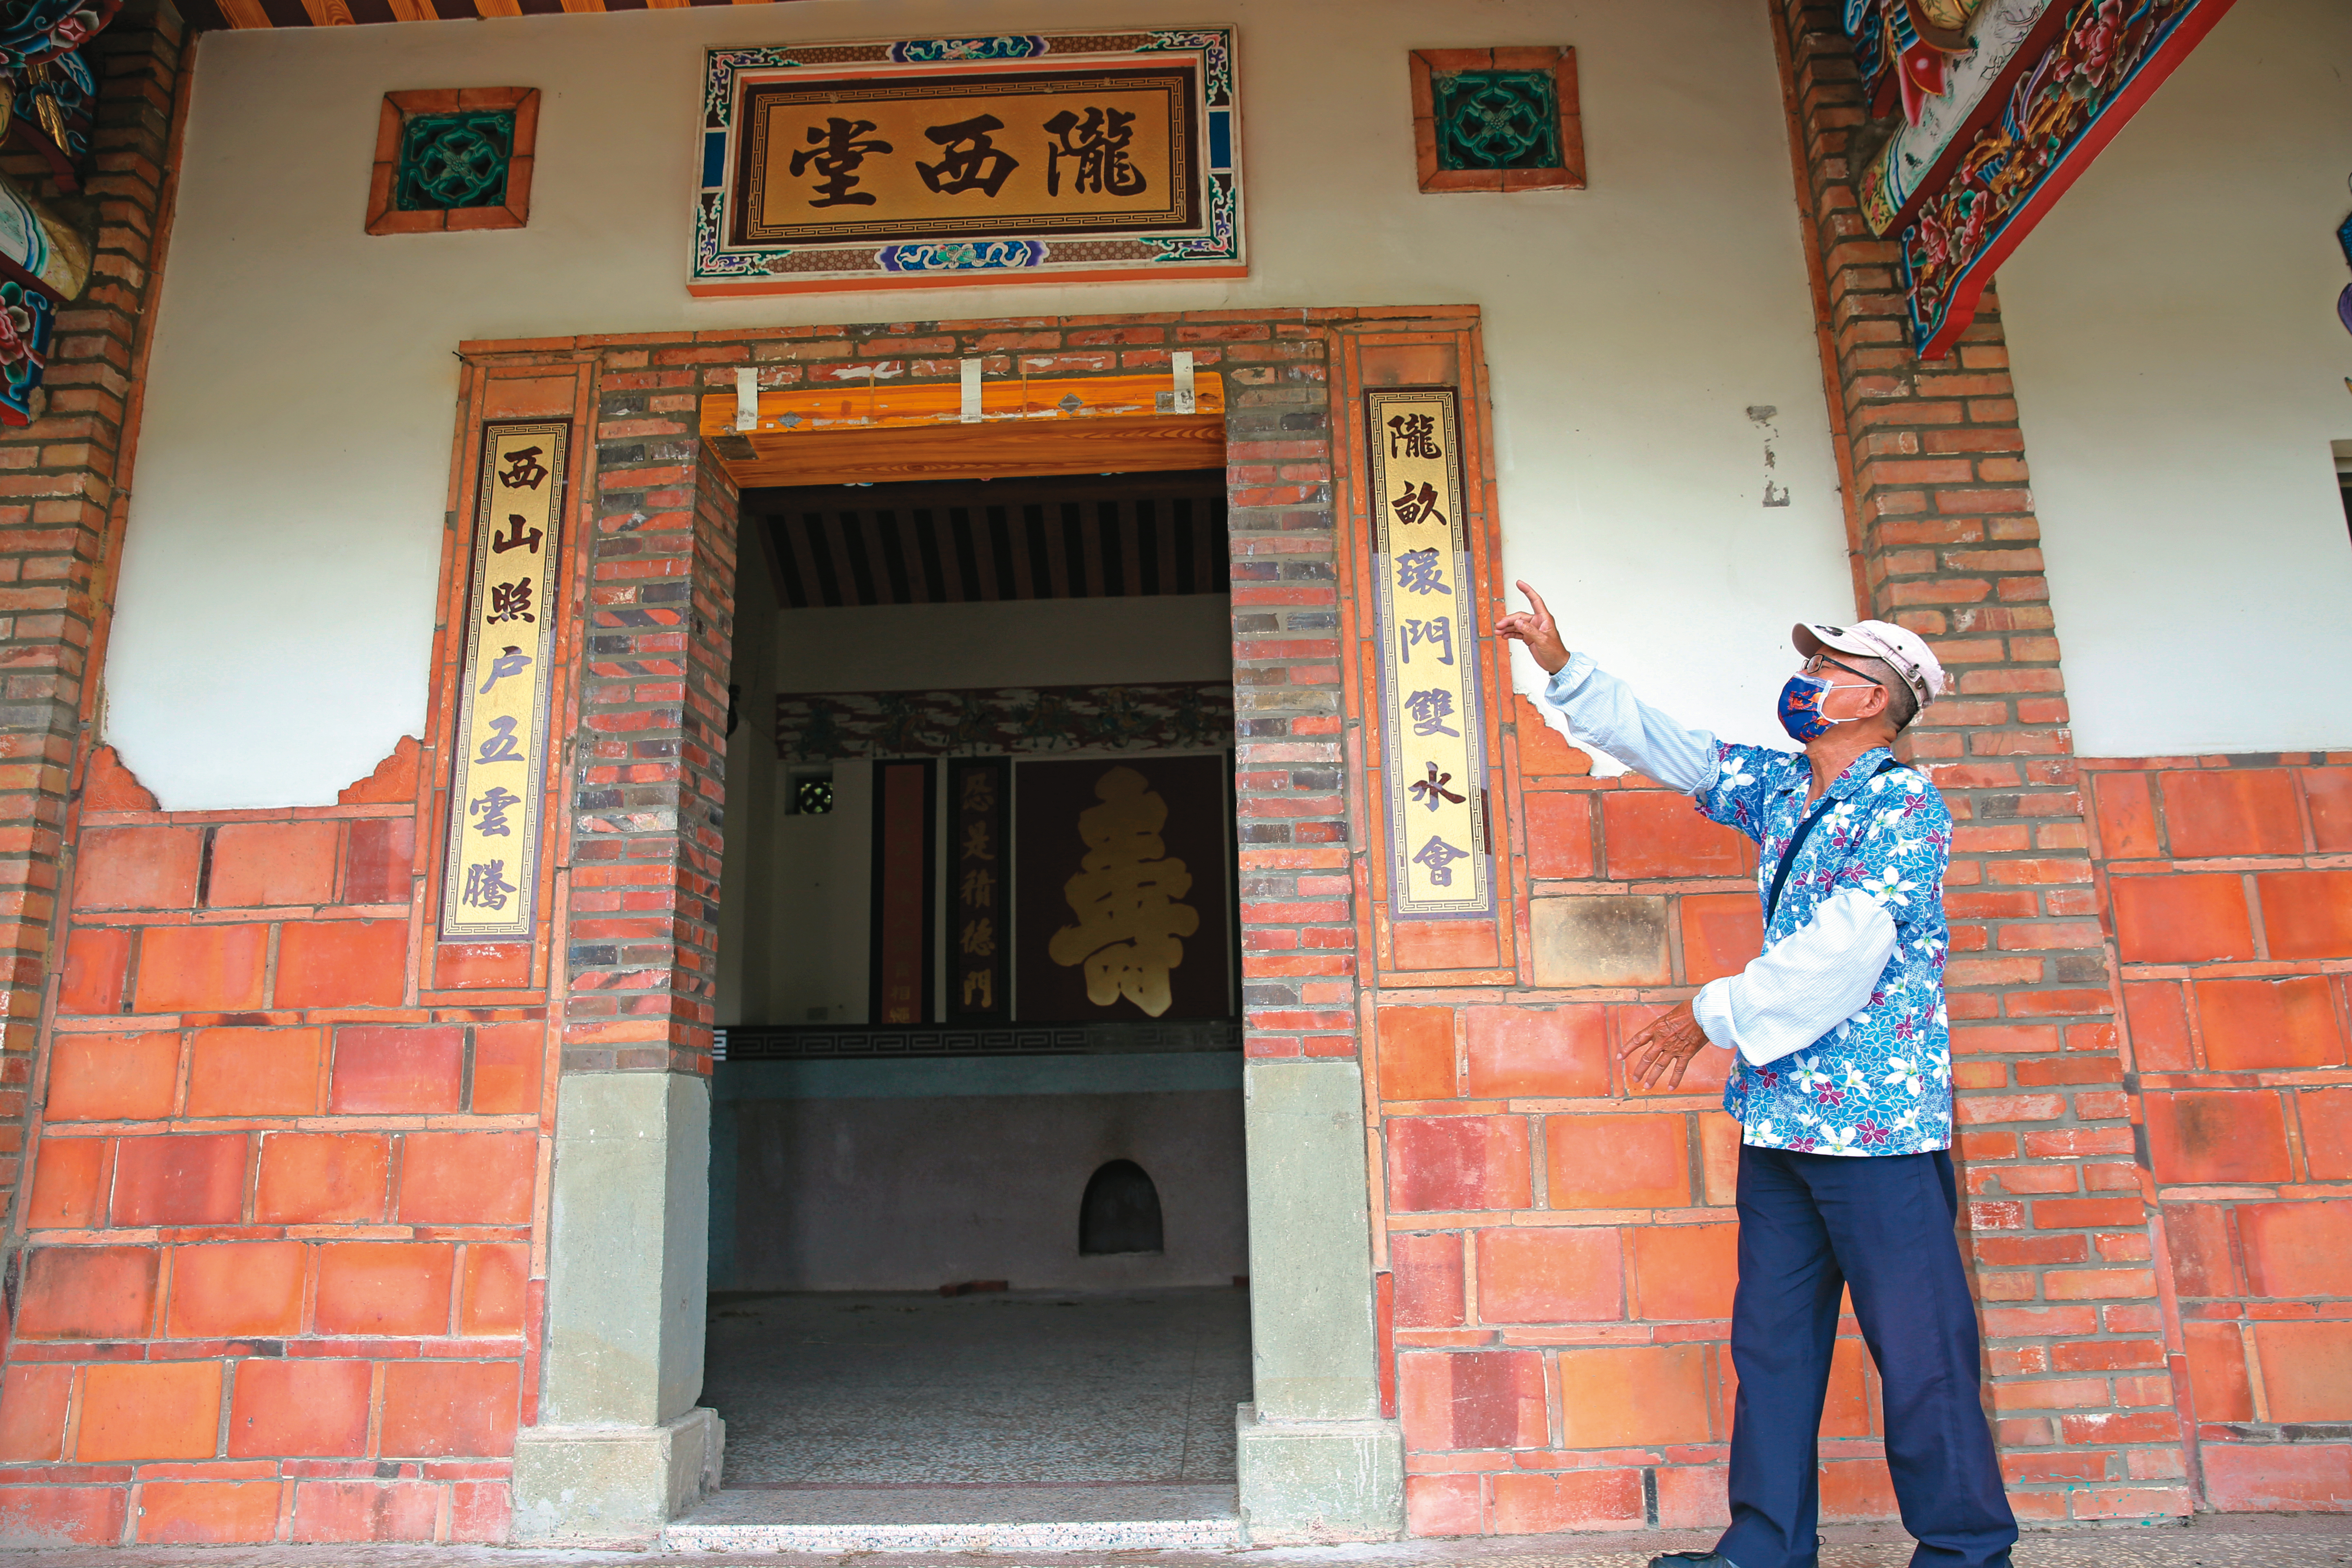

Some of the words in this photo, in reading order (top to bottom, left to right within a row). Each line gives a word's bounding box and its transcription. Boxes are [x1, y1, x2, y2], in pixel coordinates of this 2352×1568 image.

[788, 106, 1147, 208] 隴西堂
[1048, 765, 1200, 1018] 壽
